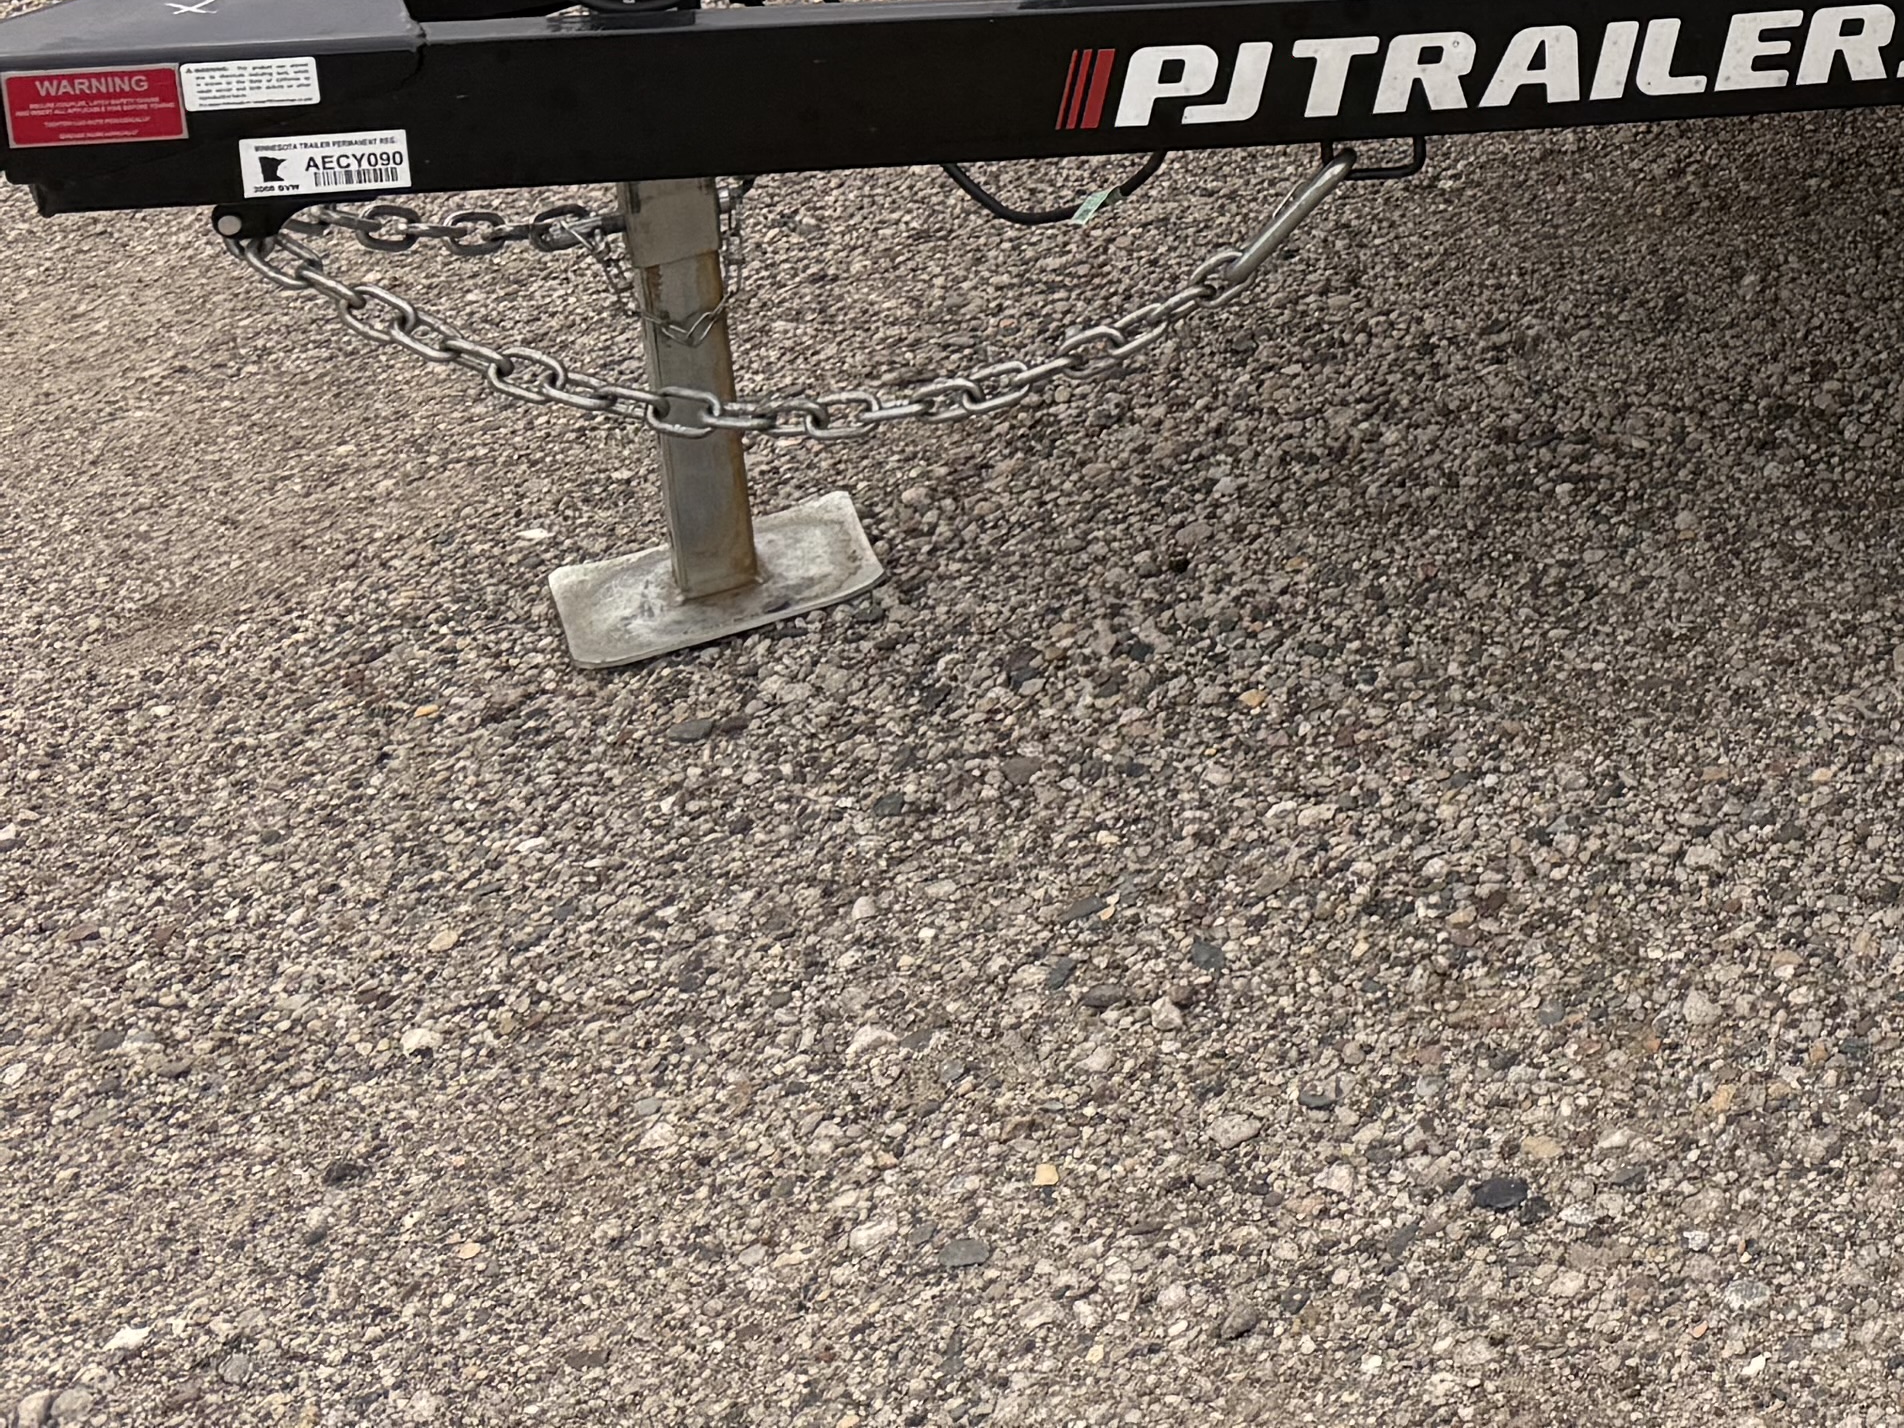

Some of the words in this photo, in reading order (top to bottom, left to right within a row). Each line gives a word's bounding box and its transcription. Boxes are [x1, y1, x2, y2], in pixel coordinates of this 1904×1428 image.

[35, 75, 149, 97] WARNING
[1115, 41, 1272, 128] PJ
[254, 144, 297, 152] MINNESOTA
[299, 141, 331, 149] TRAILER
[305, 150, 403, 172] AECY090
